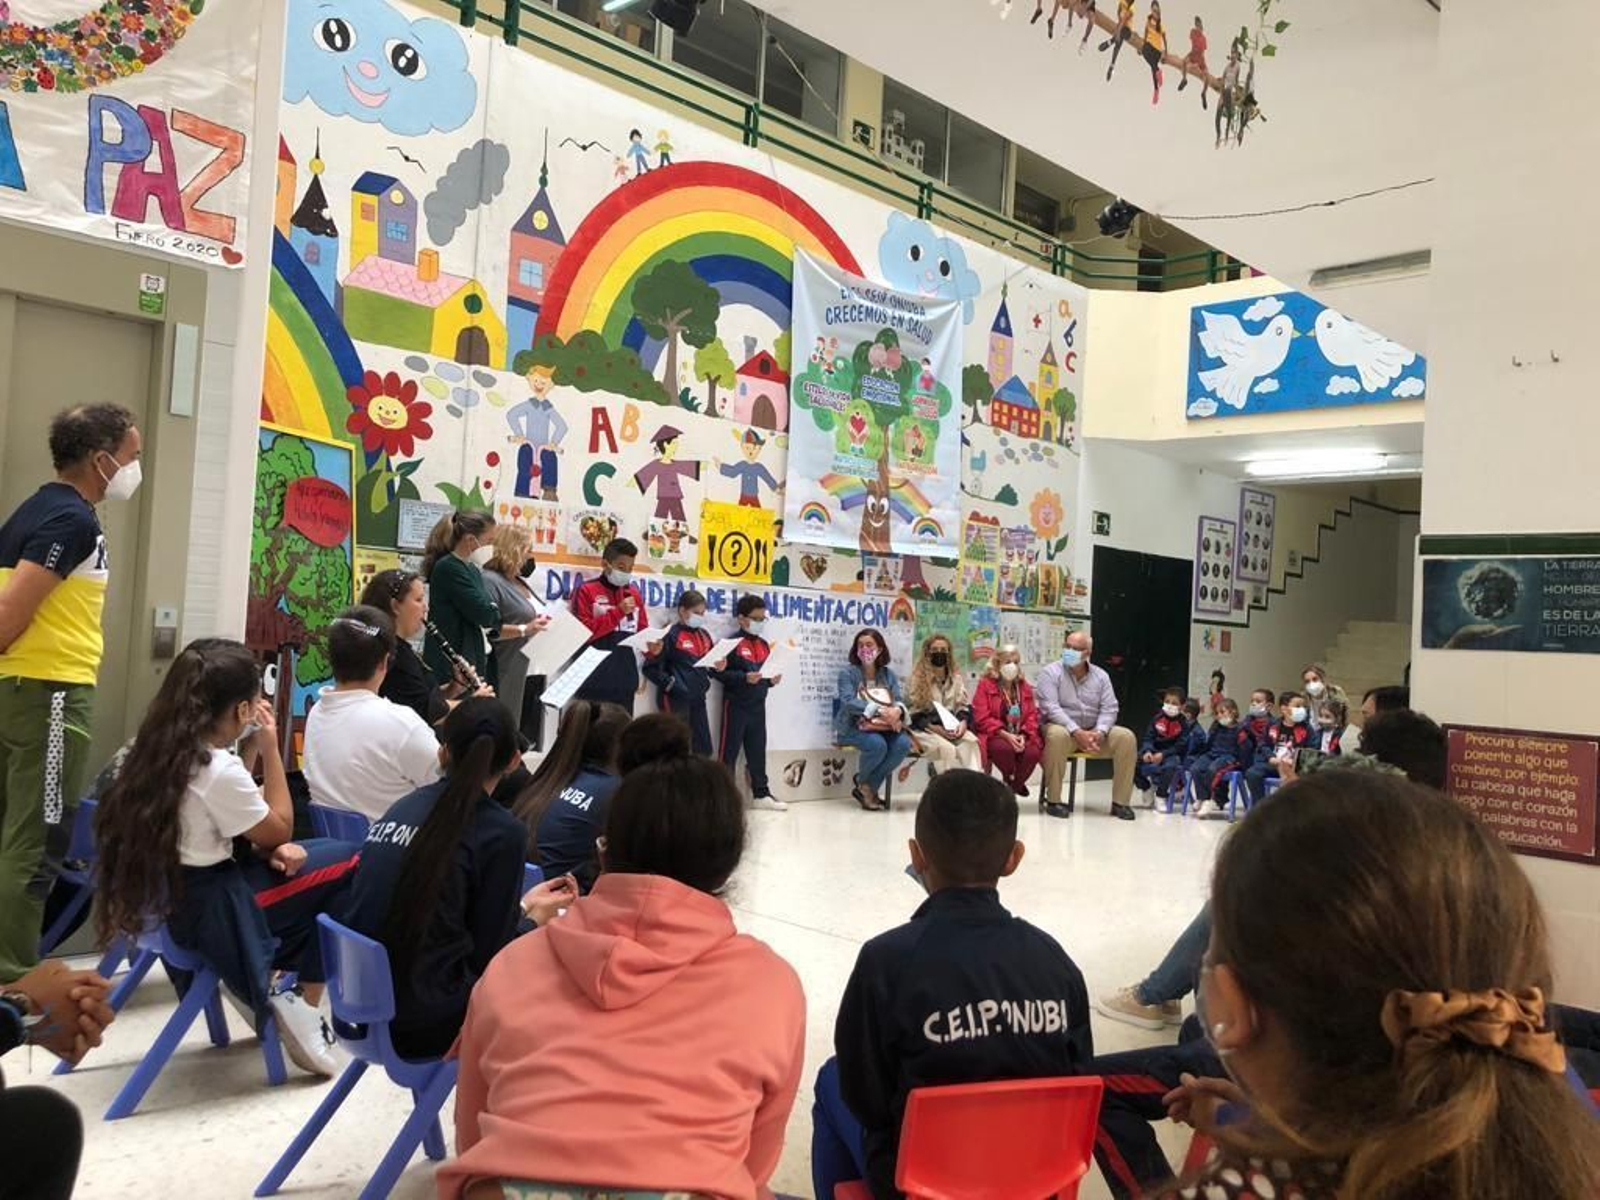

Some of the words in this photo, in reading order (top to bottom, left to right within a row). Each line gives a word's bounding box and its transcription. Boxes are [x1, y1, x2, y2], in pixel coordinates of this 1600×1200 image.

[84, 94, 246, 245] PAZ
[825, 303, 888, 325] CRECEMOS
[891, 315, 905, 329] EN
[906, 317, 933, 345] SALUD
[1544, 561, 1560, 570] LA
[1562, 560, 1600, 570] TIERRA
[706, 586, 727, 613] DE
[1543, 585, 1600, 595] HOMBRE
[1543, 610, 1560, 620] ES
[1563, 610, 1581, 620] DE
[1583, 610, 1600, 620] LA
[1543, 624, 1600, 637] TIERRA
[1465, 732, 1515, 749] Procura
[1518, 737, 1569, 754] siempre
[1464, 749, 1512, 763] ponerte
[1515, 753, 1541, 769] algo
[1543, 758, 1569, 770] que
[1505, 768, 1527, 780] por
[1455, 777, 1468, 788] La
[1471, 779, 1515, 794] cabeza
[1518, 785, 1541, 798] que
[1545, 786, 1576, 805] haga
[1487, 797, 1509, 809] con
[1512, 800, 1523, 810] el
[1526, 801, 1578, 818] corazón
[1482, 811, 1537, 828] palabras
[1540, 820, 1563, 832] con
[1567, 821, 1578, 833] la
